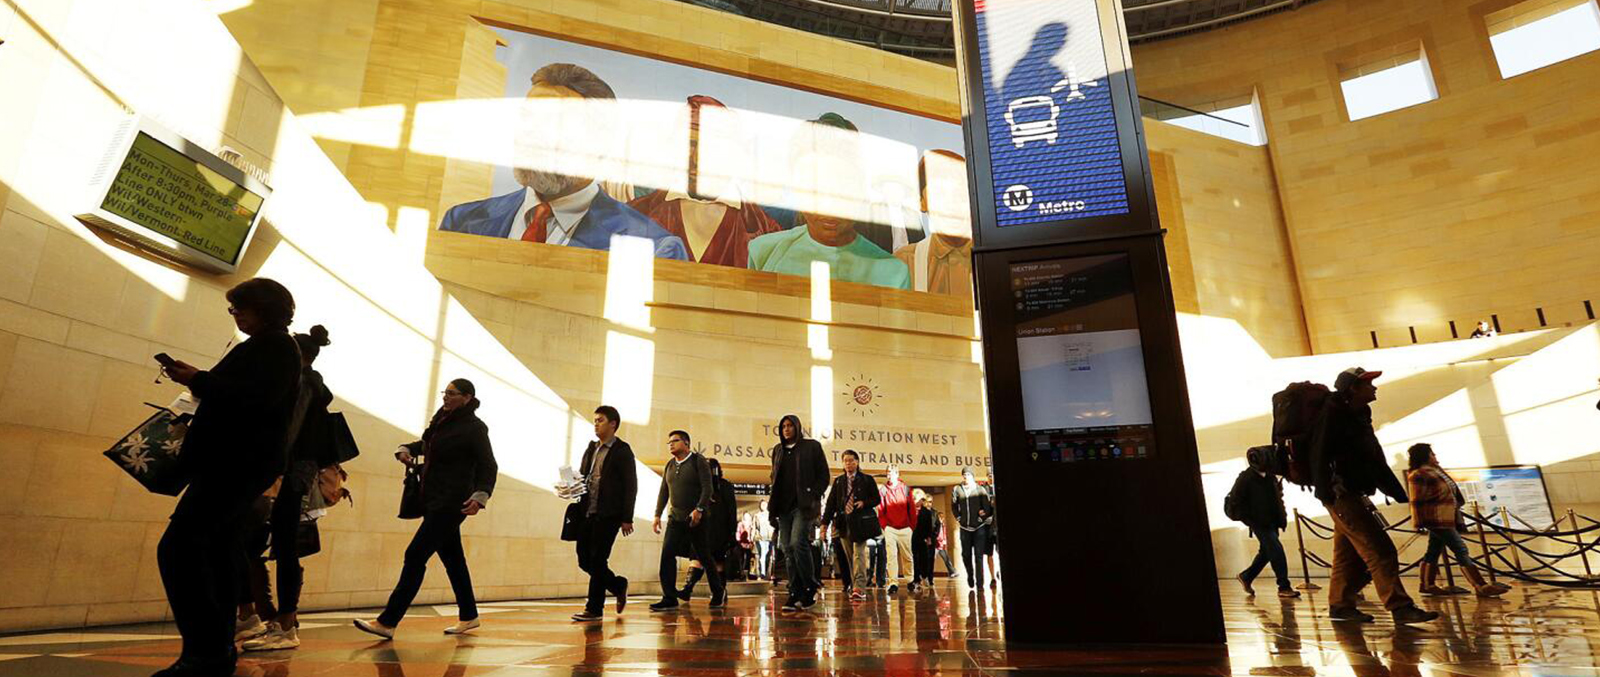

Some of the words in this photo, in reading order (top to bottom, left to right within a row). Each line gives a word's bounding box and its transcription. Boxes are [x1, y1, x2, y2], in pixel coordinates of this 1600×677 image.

[130, 150, 192, 190] Mon-Thurs,
[195, 184, 216, 200] Mar
[117, 172, 143, 192] Line
[146, 186, 178, 207] ONLY
[178, 202, 204, 220] btwn
[121, 162, 153, 181] After
[201, 200, 233, 222] Purple
[1038, 200, 1086, 214] Metro
[183, 230, 205, 245] Red
[204, 239, 226, 257] Line
[850, 430, 914, 443] STATION
[918, 433, 958, 446] WEST
[859, 452, 914, 464] TRAINS
[920, 454, 949, 466] AND
